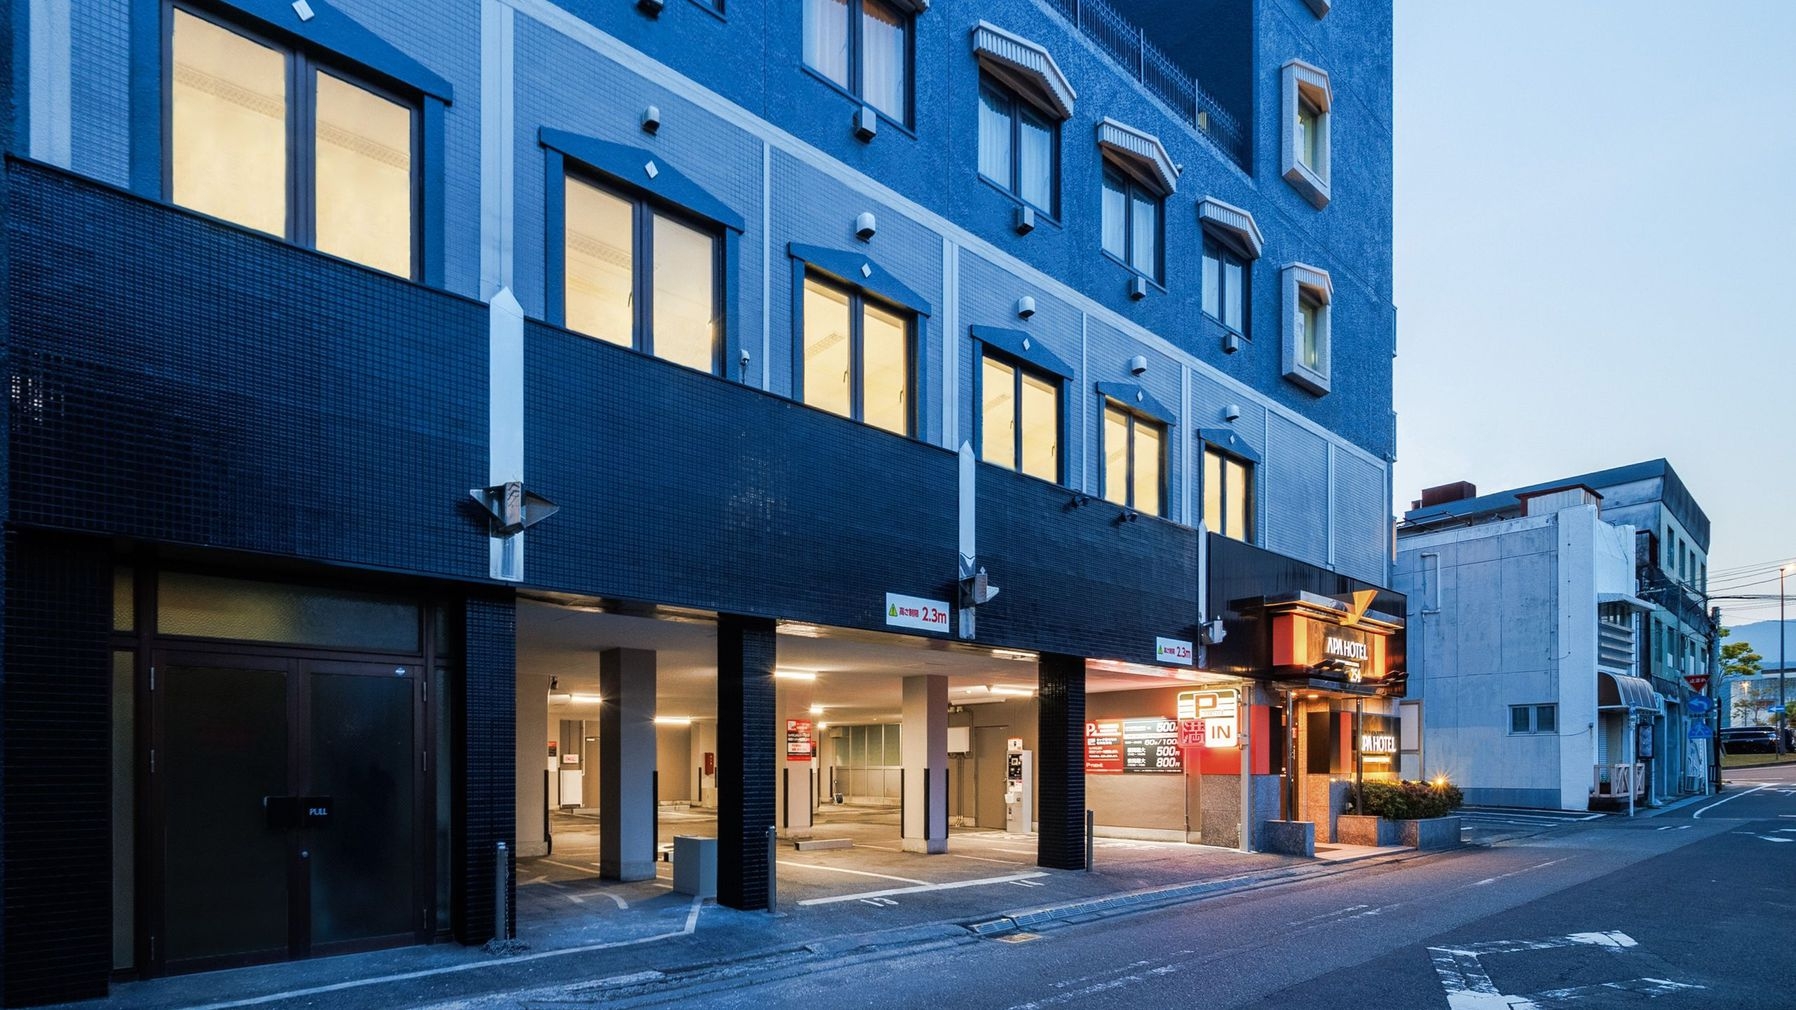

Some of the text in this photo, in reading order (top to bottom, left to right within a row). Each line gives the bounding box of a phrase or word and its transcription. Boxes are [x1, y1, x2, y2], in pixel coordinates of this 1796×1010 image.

[922, 606, 947, 624] 2.3m
[1343, 640, 1369, 660] HOTEL
[1195, 694, 1217, 718] P
[1184, 721, 1204, 743] 満
[1212, 725, 1231, 739] IN
[1361, 735, 1397, 753] PA HOTEL
[309, 807, 328, 816] PULL
